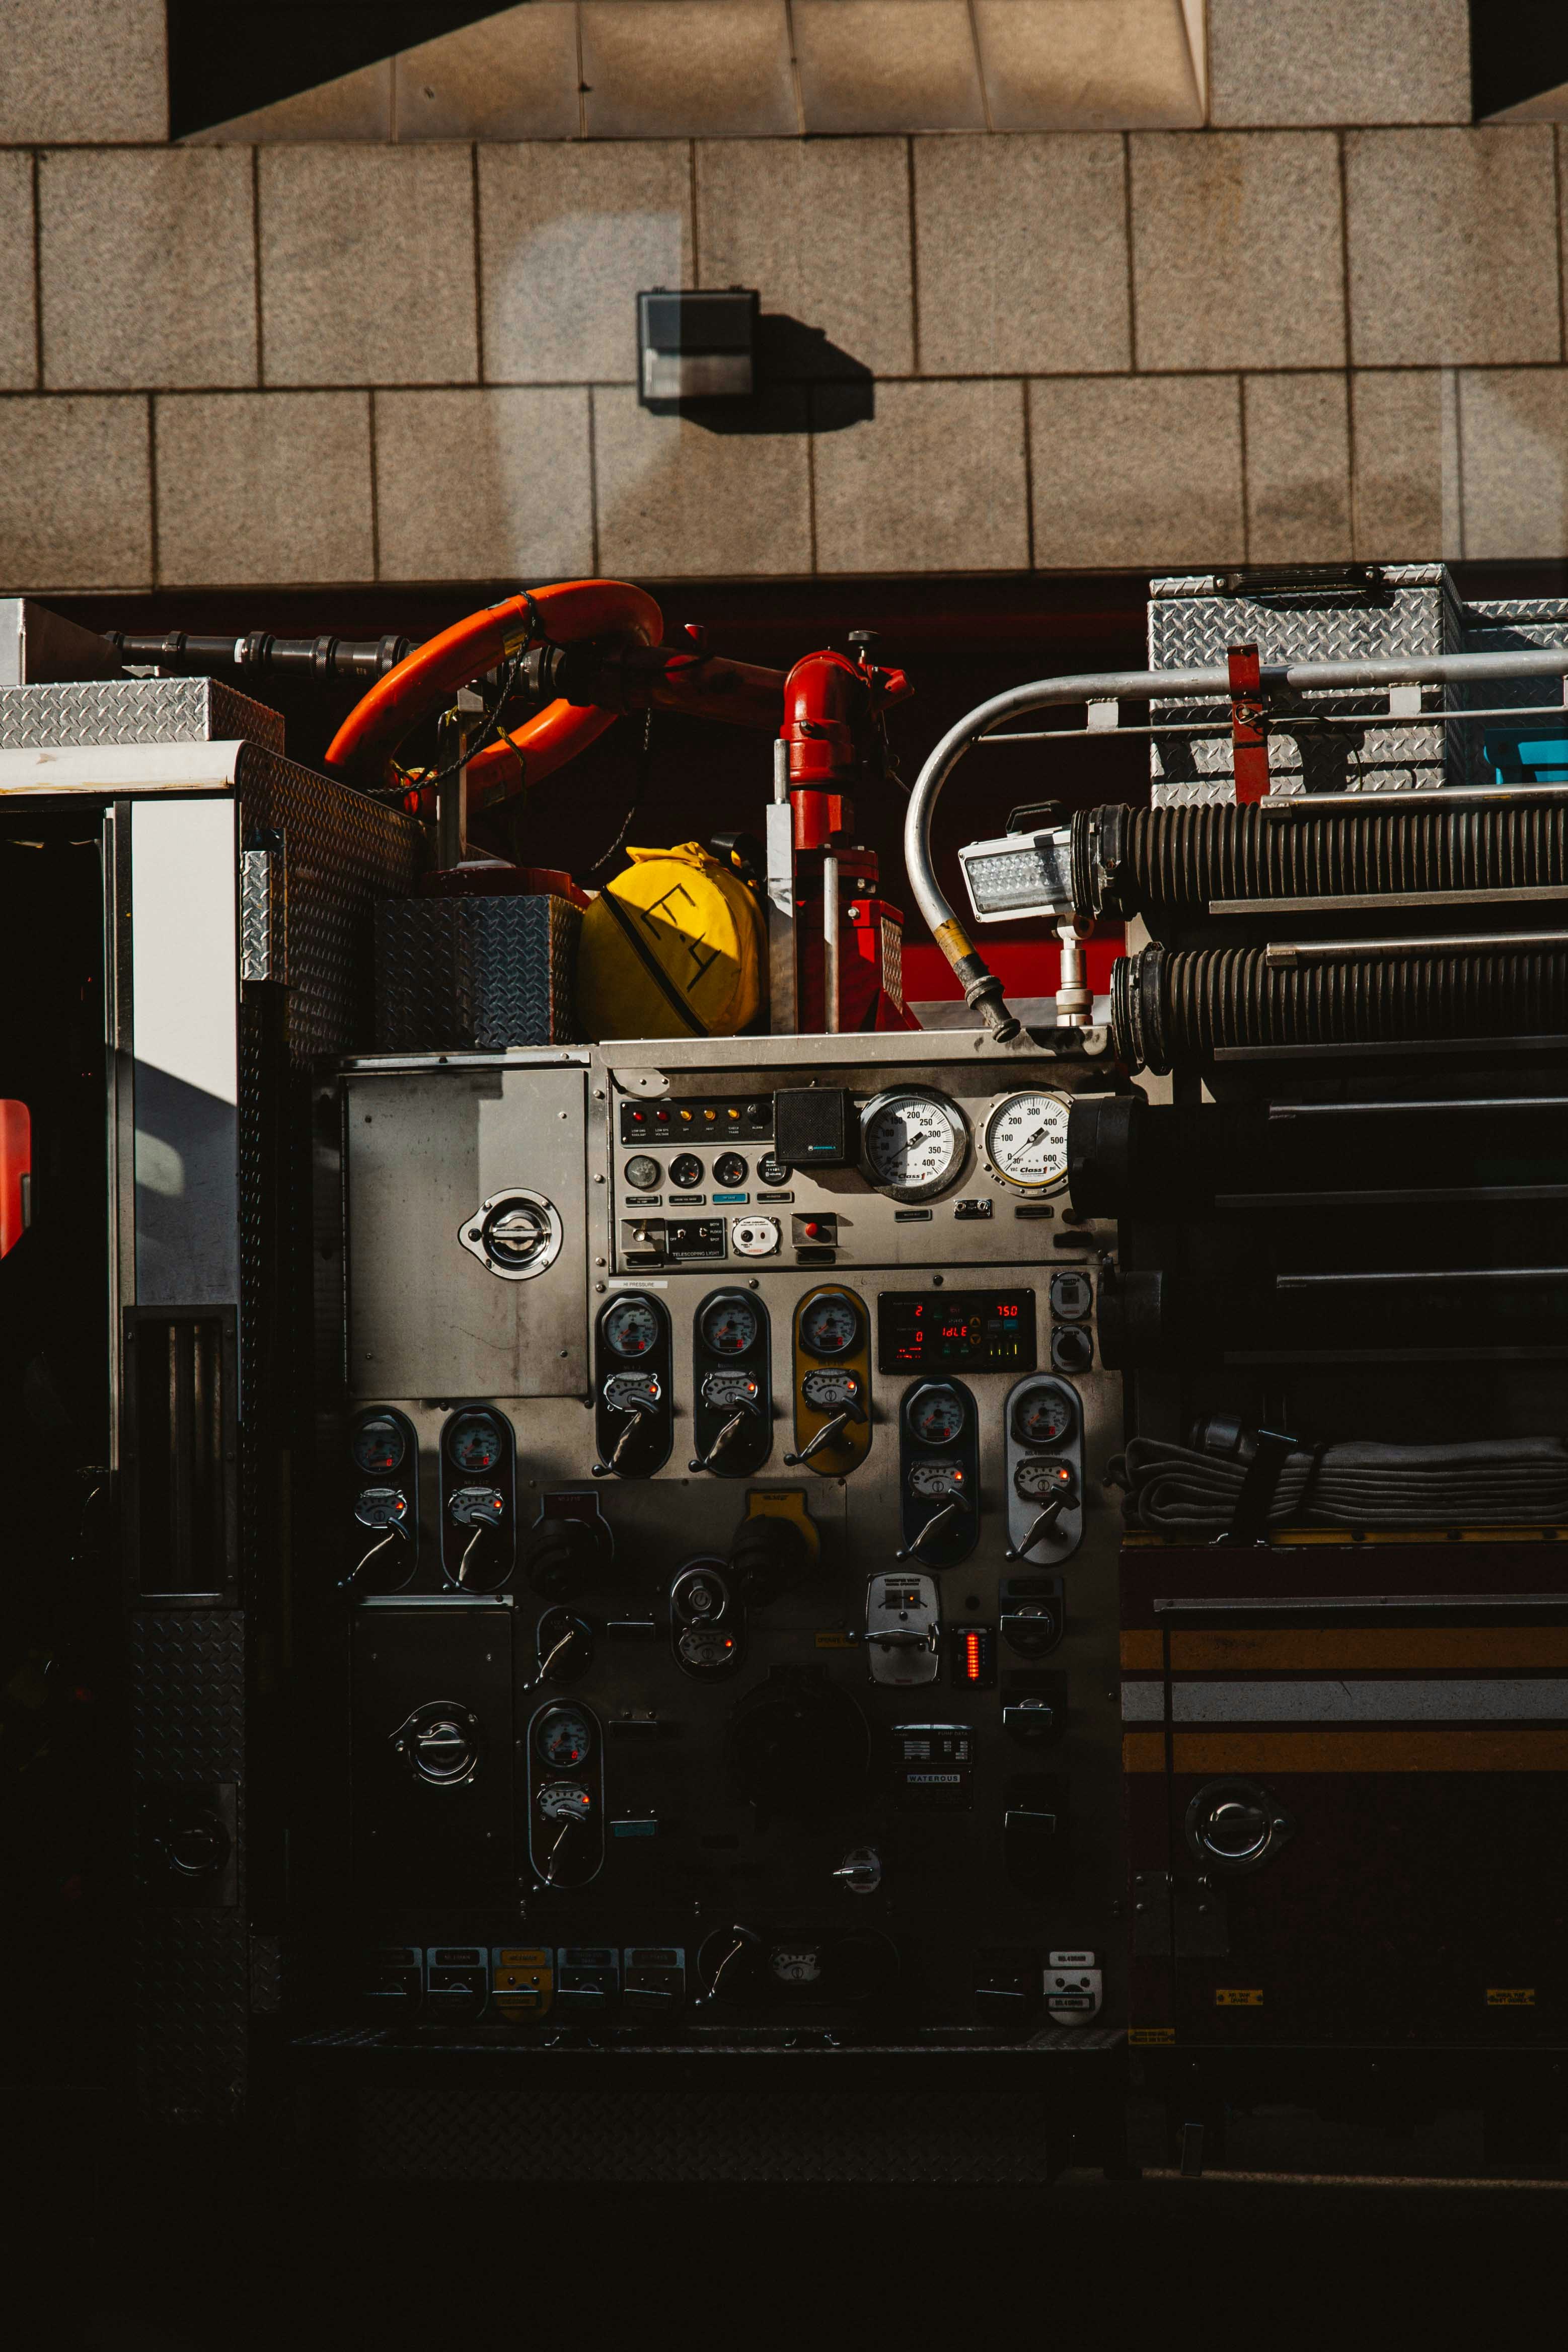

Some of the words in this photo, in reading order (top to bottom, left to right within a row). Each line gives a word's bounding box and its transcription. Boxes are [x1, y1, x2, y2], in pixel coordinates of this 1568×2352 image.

[915, 1306, 923, 1316] 2
[997, 1306, 1018, 1316] 750
[916, 1332, 923, 1342] 0
